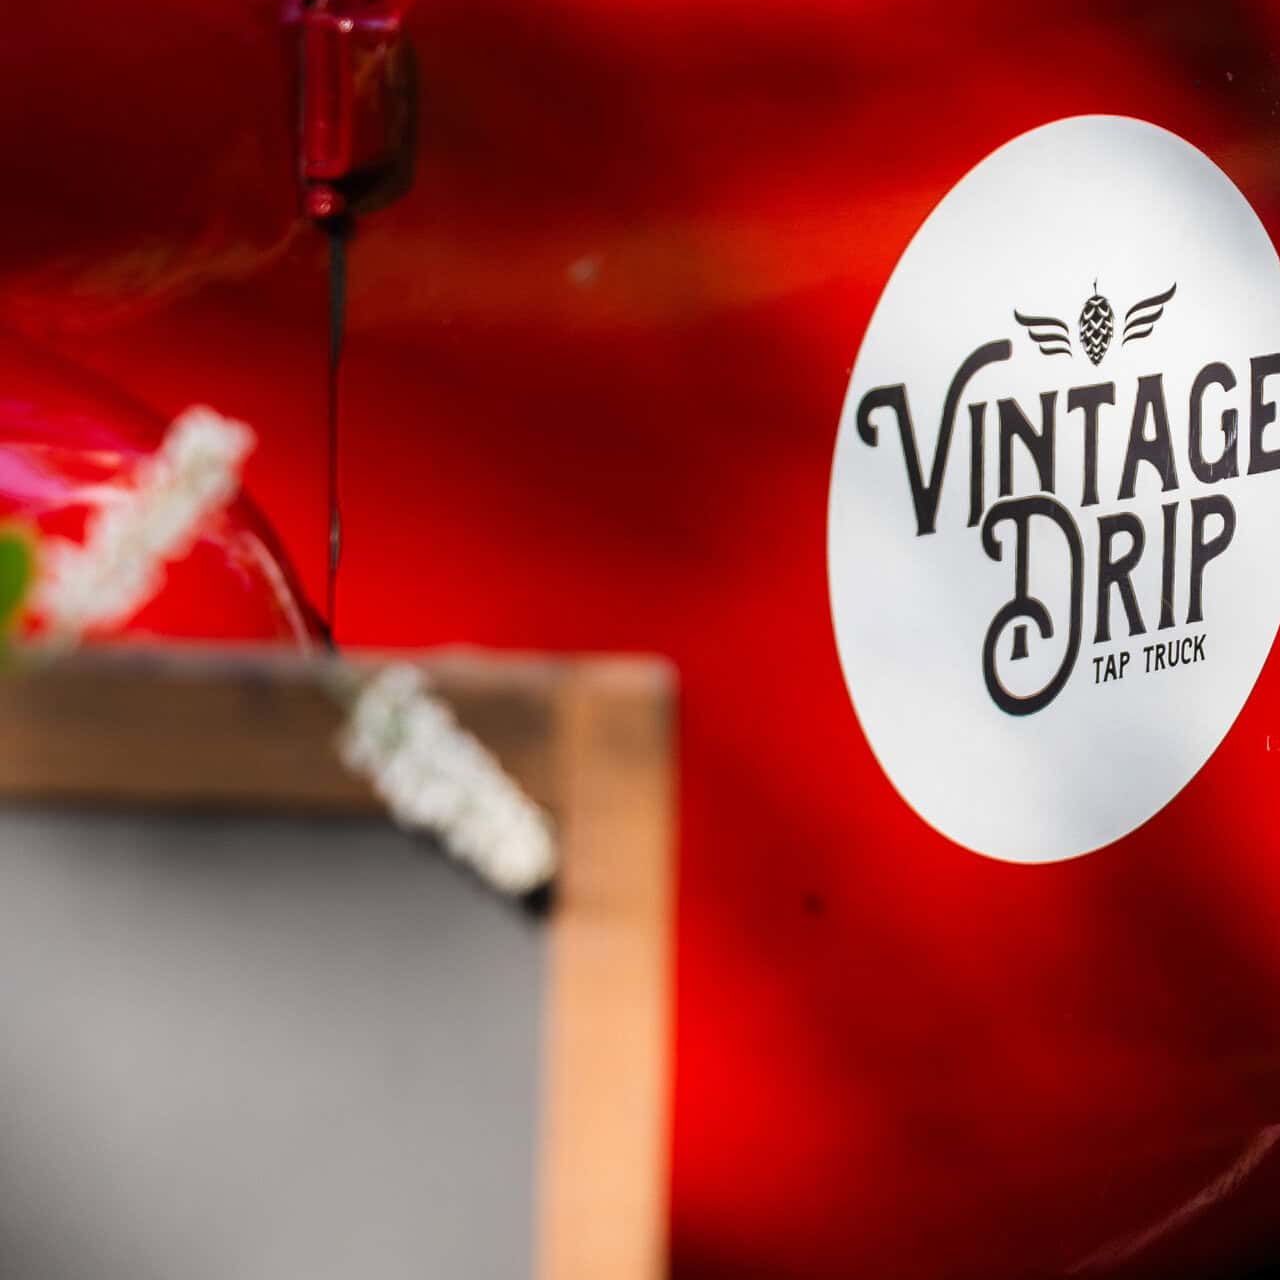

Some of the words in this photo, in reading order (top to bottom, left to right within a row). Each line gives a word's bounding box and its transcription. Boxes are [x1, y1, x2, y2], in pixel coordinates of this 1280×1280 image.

[982, 494, 1236, 716] DRIP
[1093, 651, 1130, 684] TAP
[1143, 634, 1206, 671] TRUCK
